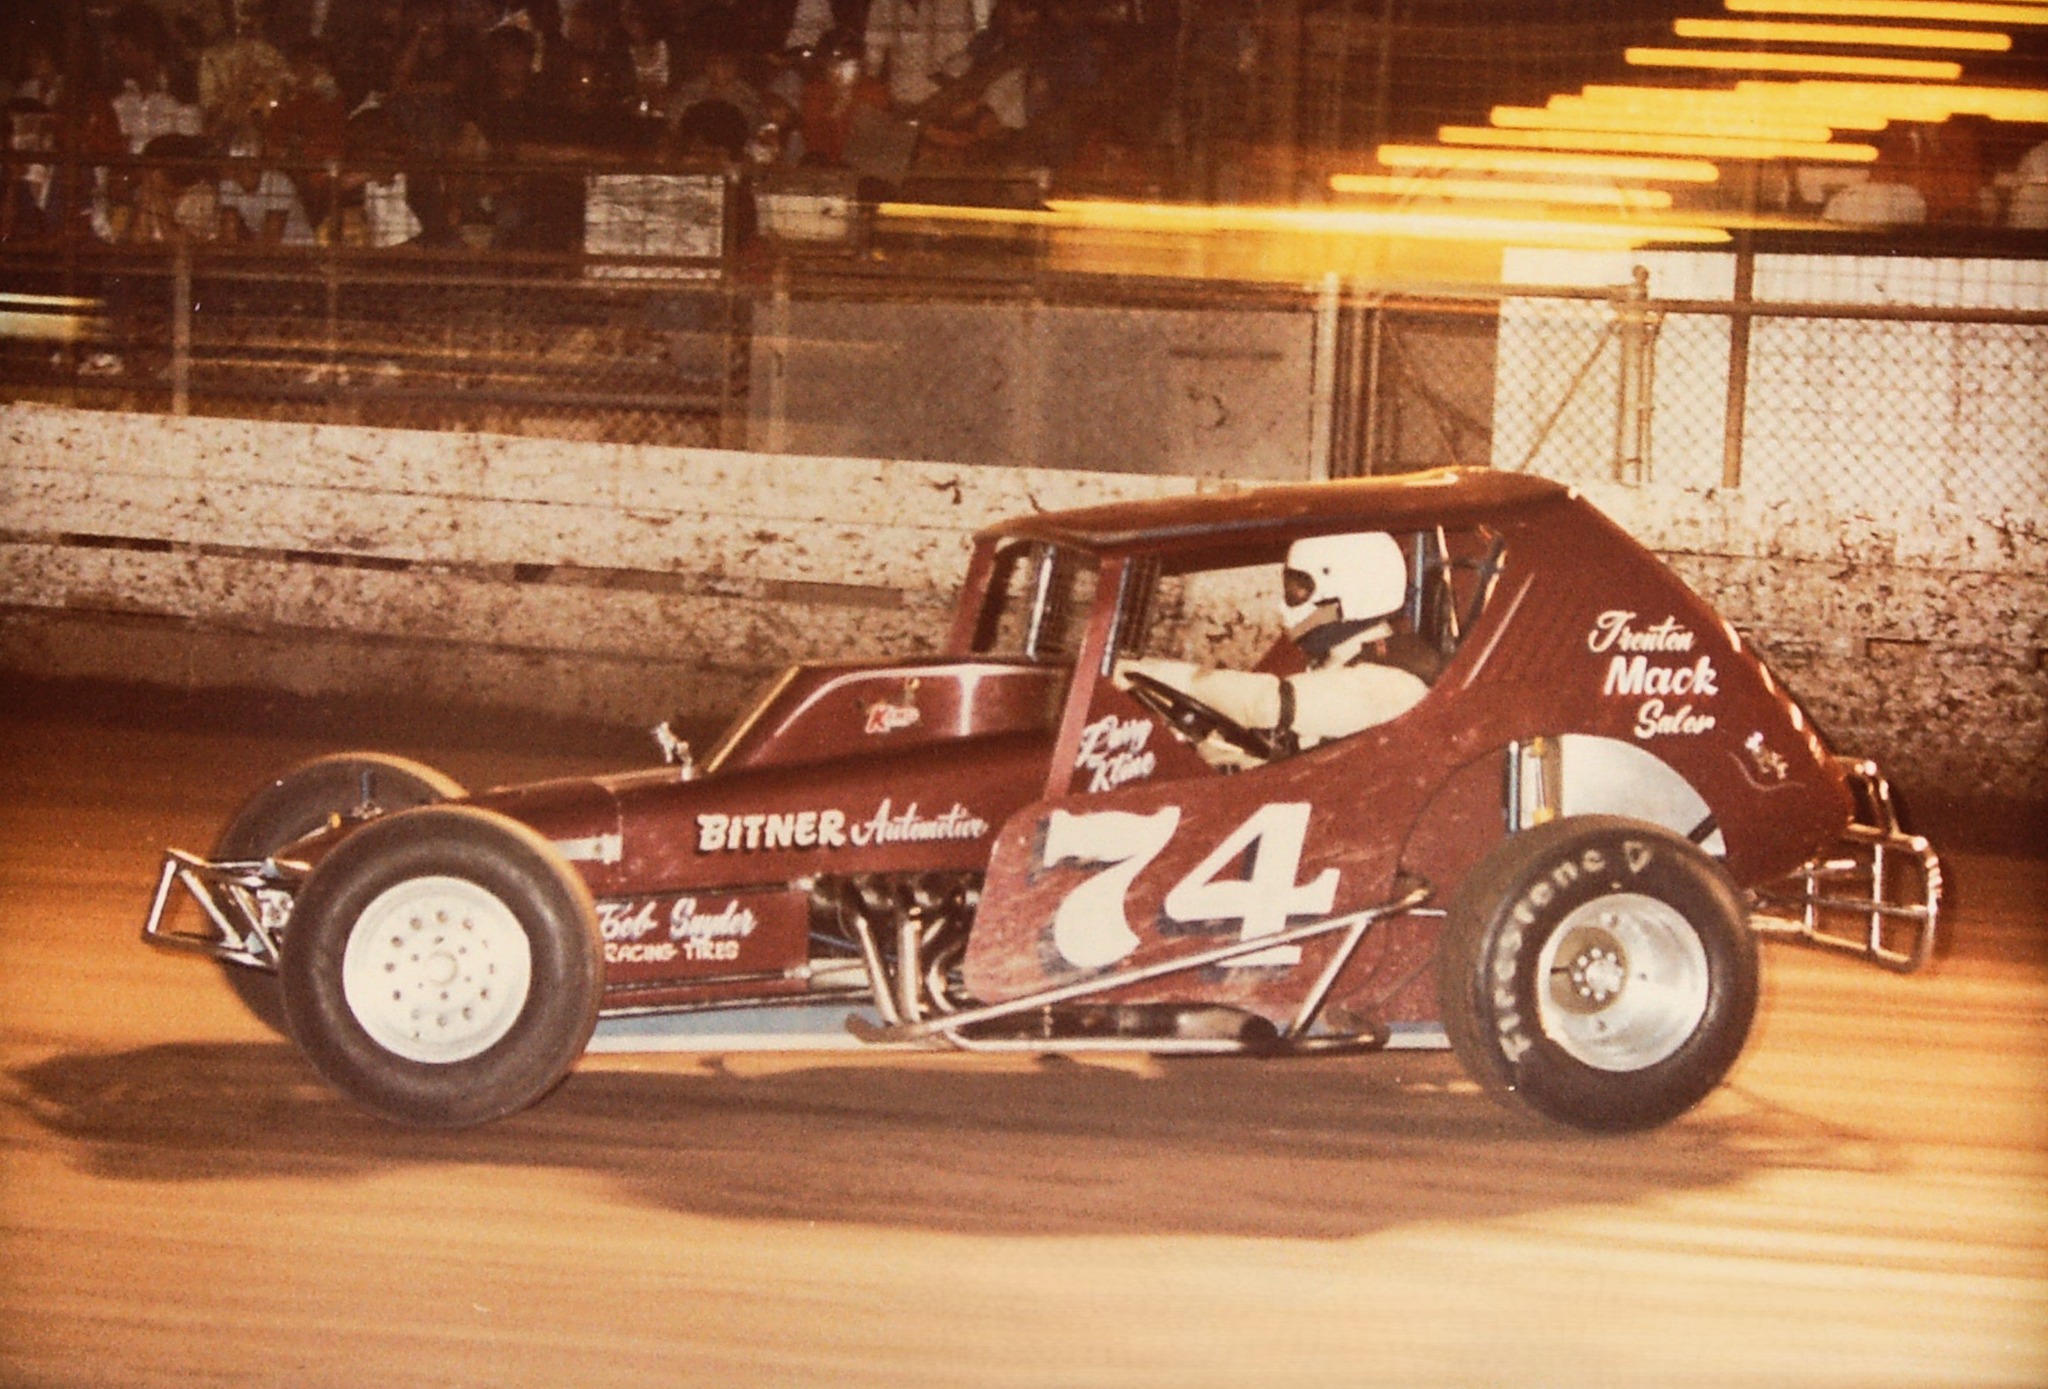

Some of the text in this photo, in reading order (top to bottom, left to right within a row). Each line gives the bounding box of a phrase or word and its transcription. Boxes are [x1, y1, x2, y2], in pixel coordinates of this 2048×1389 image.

[1588, 610, 1695, 652] Trenton
[1603, 655, 1719, 696] Mack
[697, 798, 988, 851] BITNER Automotive
[1043, 802, 1341, 968] 74
[604, 940, 740, 963] RACING TIRES
